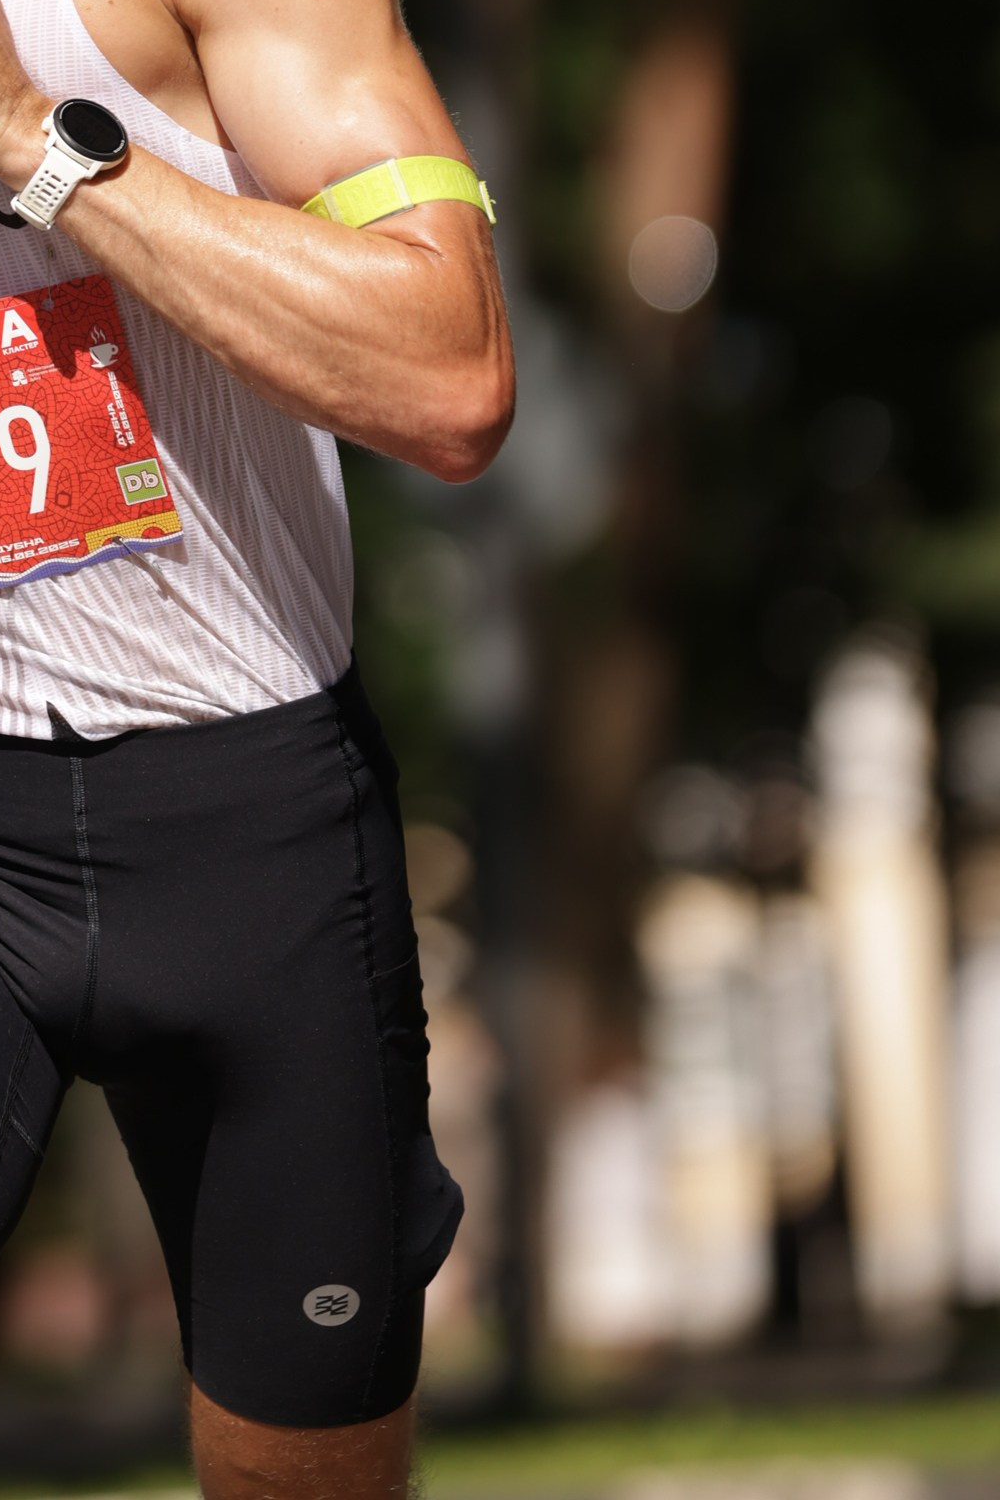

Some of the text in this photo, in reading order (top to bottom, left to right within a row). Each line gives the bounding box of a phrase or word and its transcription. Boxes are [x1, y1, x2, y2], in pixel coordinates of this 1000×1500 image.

[2, 341, 39, 356] КЛАСТЕР
[107, 402, 128, 447] ДУБНА
[124, 470, 160, 493] Db
